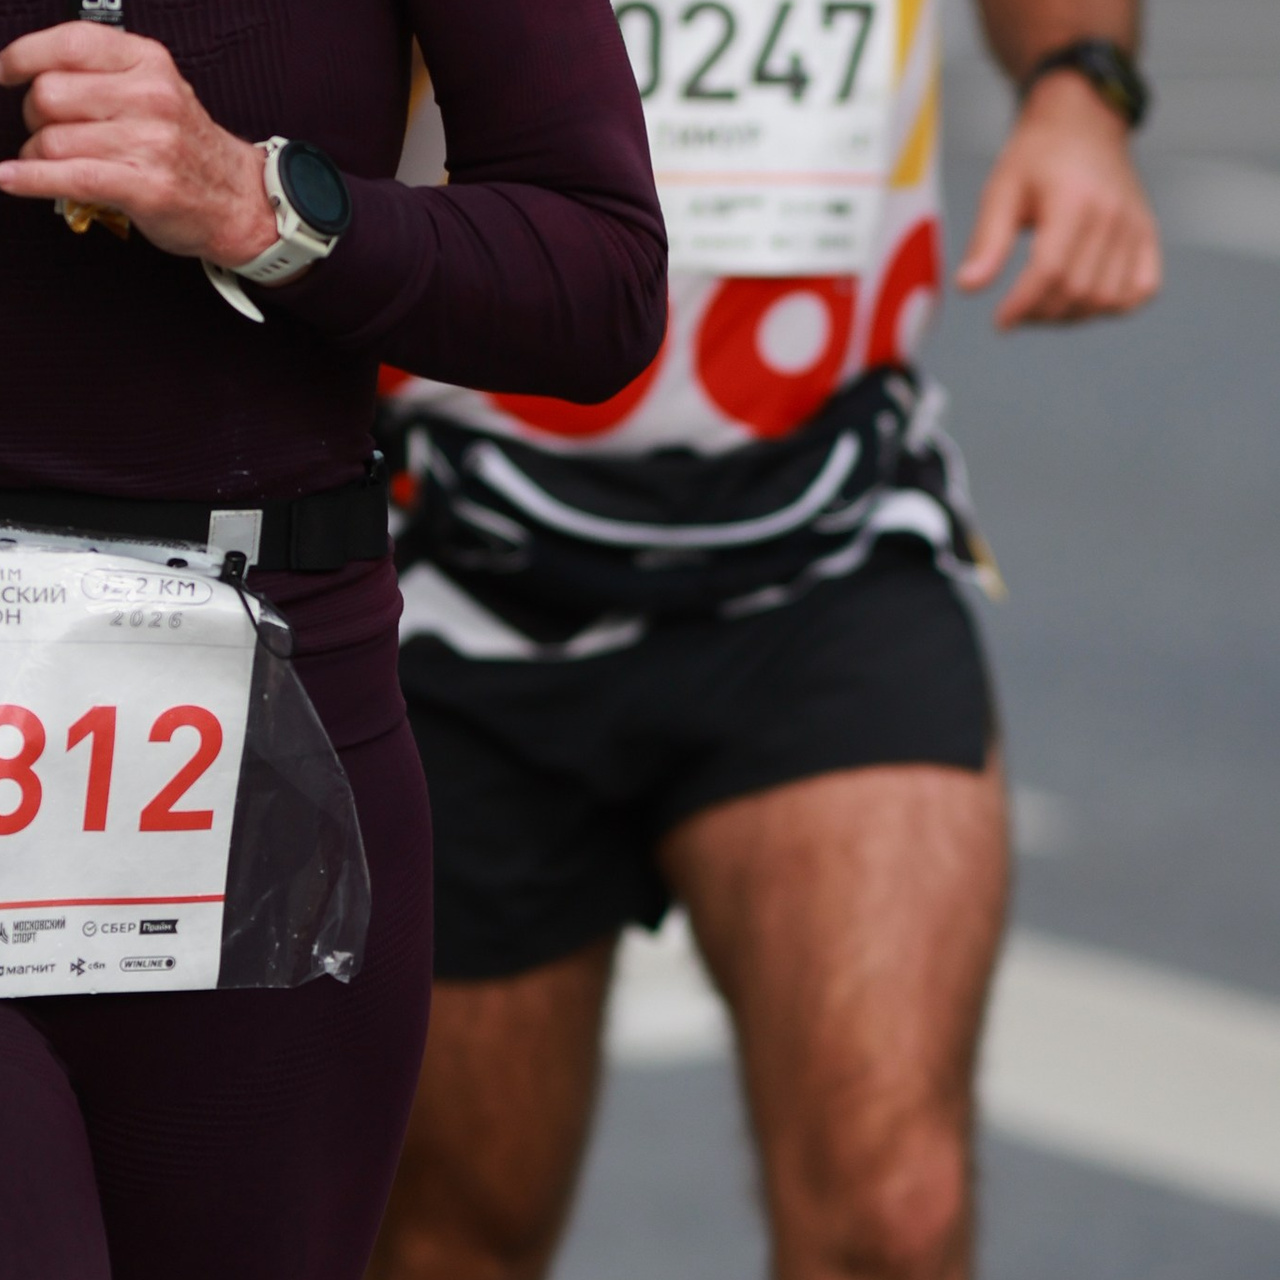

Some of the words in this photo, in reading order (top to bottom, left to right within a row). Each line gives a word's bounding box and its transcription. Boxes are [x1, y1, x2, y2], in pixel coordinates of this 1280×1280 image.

[110, 610, 183, 628] 2026
[12, 916, 67, 931] МОСКОВСКИЙ
[100, 922, 136, 934] СБЕР
[12, 932, 38, 944] СПОРТ
[124, 959, 164, 968] WINLINE
